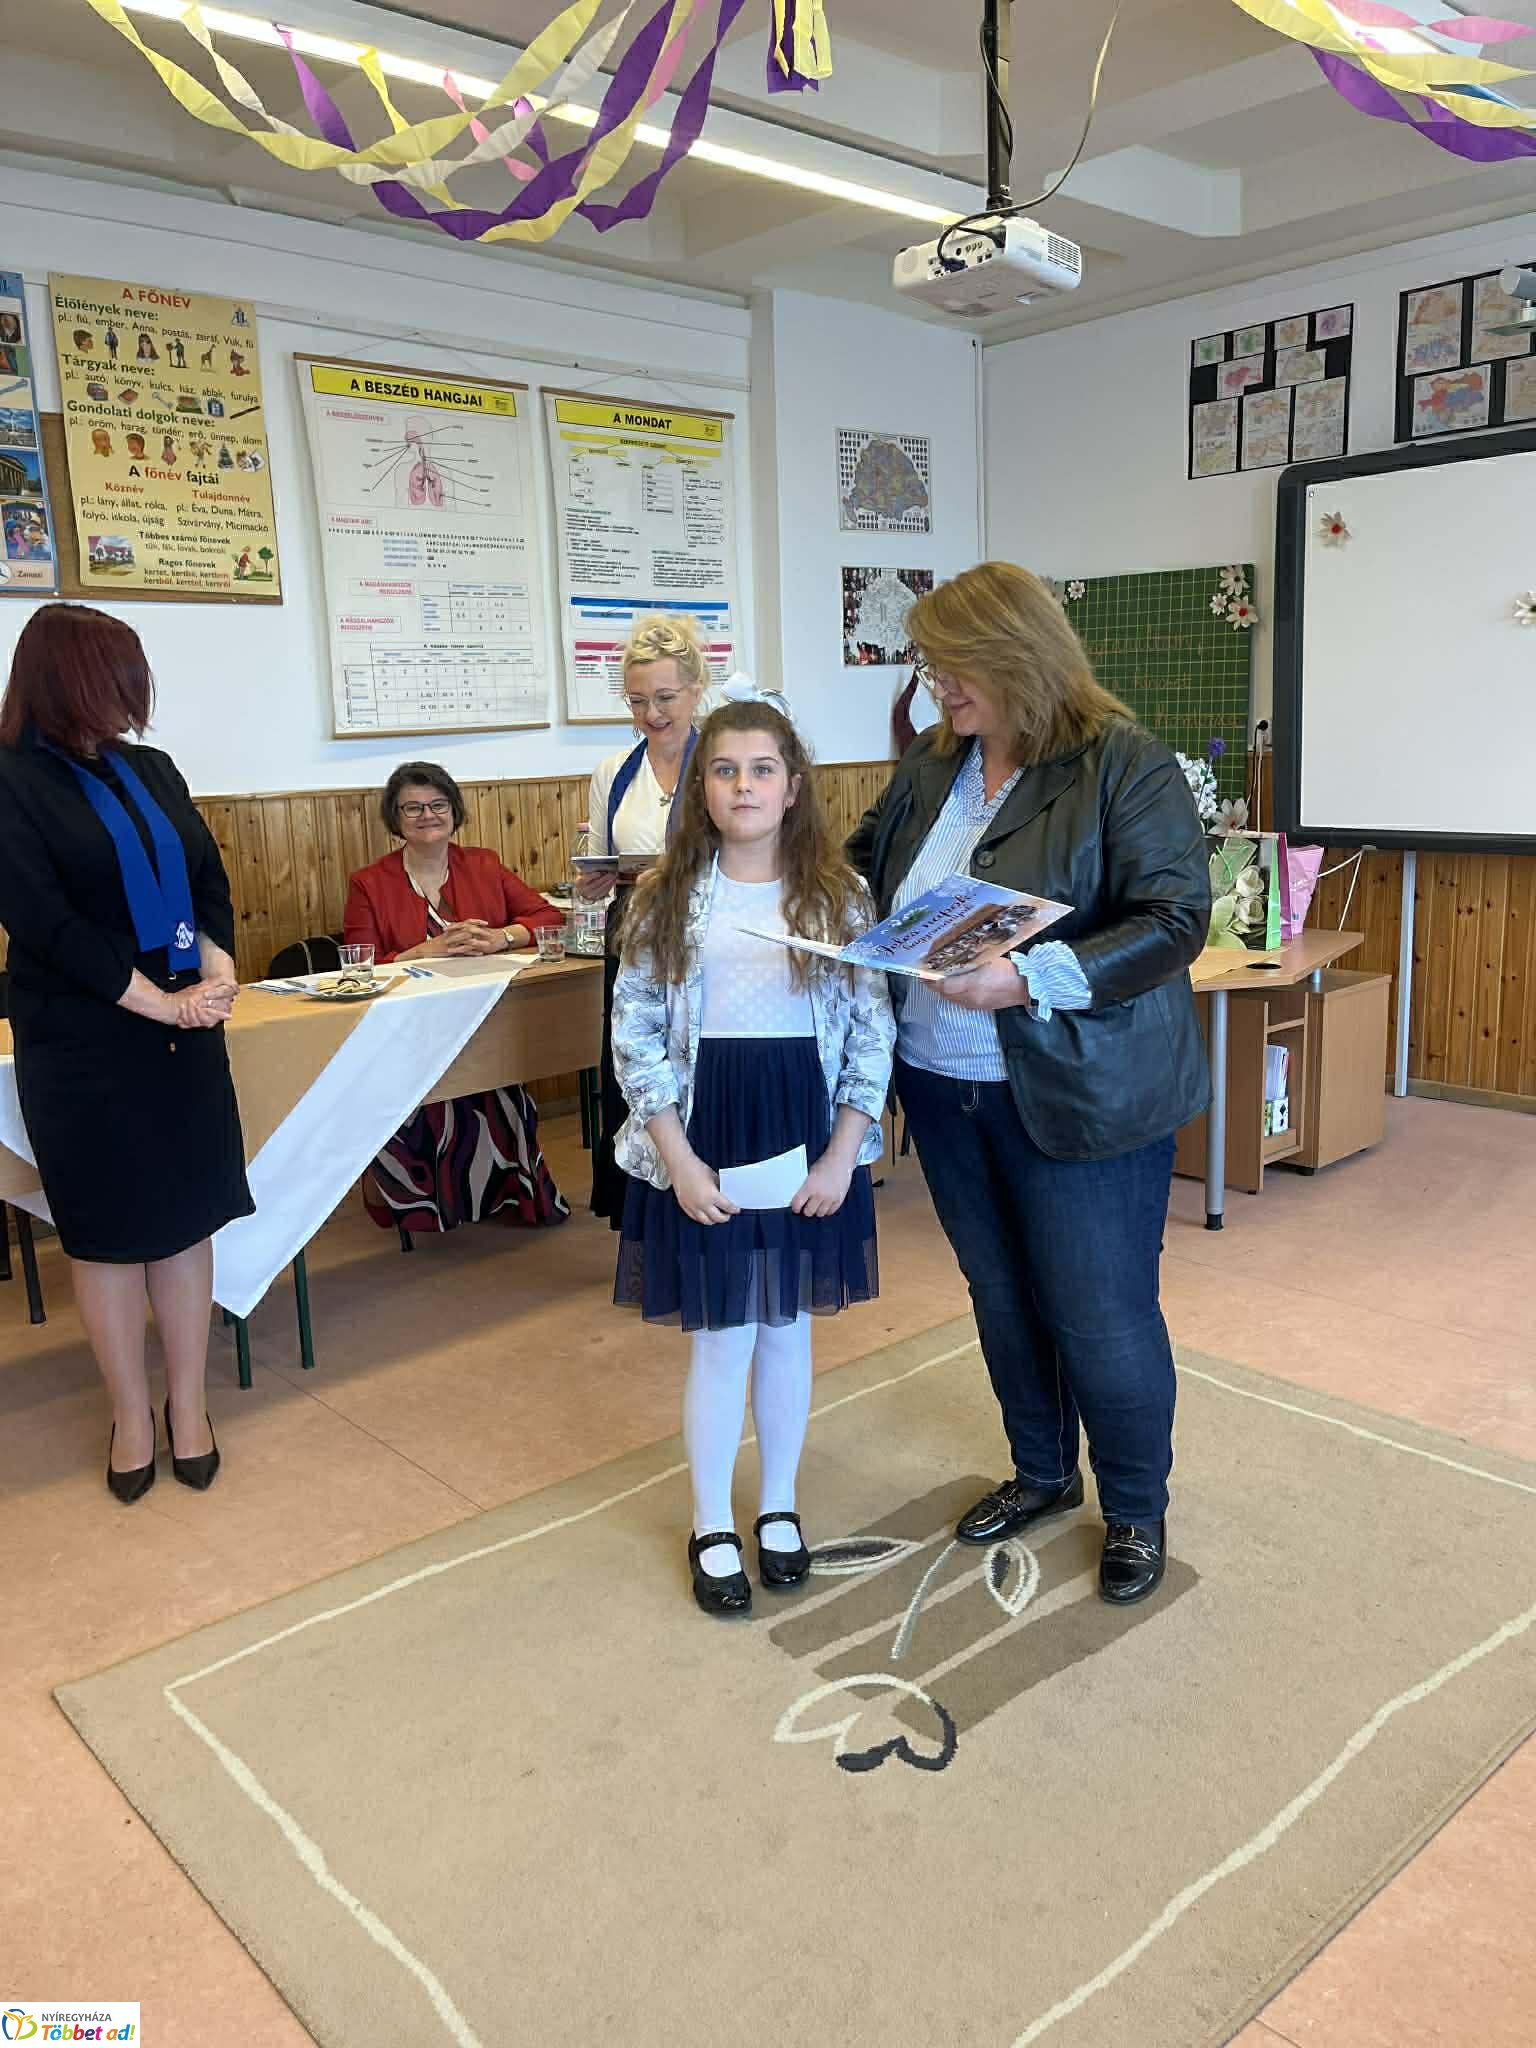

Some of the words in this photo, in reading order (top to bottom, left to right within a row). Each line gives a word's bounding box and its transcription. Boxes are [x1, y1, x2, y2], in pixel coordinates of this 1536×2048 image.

[55, 295, 121, 315] Élőlények
[124, 306, 159, 321] neve:
[122, 287, 134, 300] A
[138, 289, 192, 310] FŐNÉV
[61, 354, 117, 372] Tárgyak
[121, 363, 155, 377] neve:
[350, 379, 360, 392] A
[364, 379, 420, 399] BESZÉD
[423, 387, 482, 408] HANGJAI
[67, 399, 132, 419] Gondolati
[136, 407, 178, 426] dolgok
[182, 415, 216, 428] neve:
[613, 412, 622, 424] A
[625, 413, 673, 430] MONDAT
[128, 465, 141, 478] A
[144, 466, 182, 481] főnév
[186, 470, 220, 487] fajtái
[104, 481, 145, 495] Köznév
[192, 489, 251, 504] Tulajdonnév
